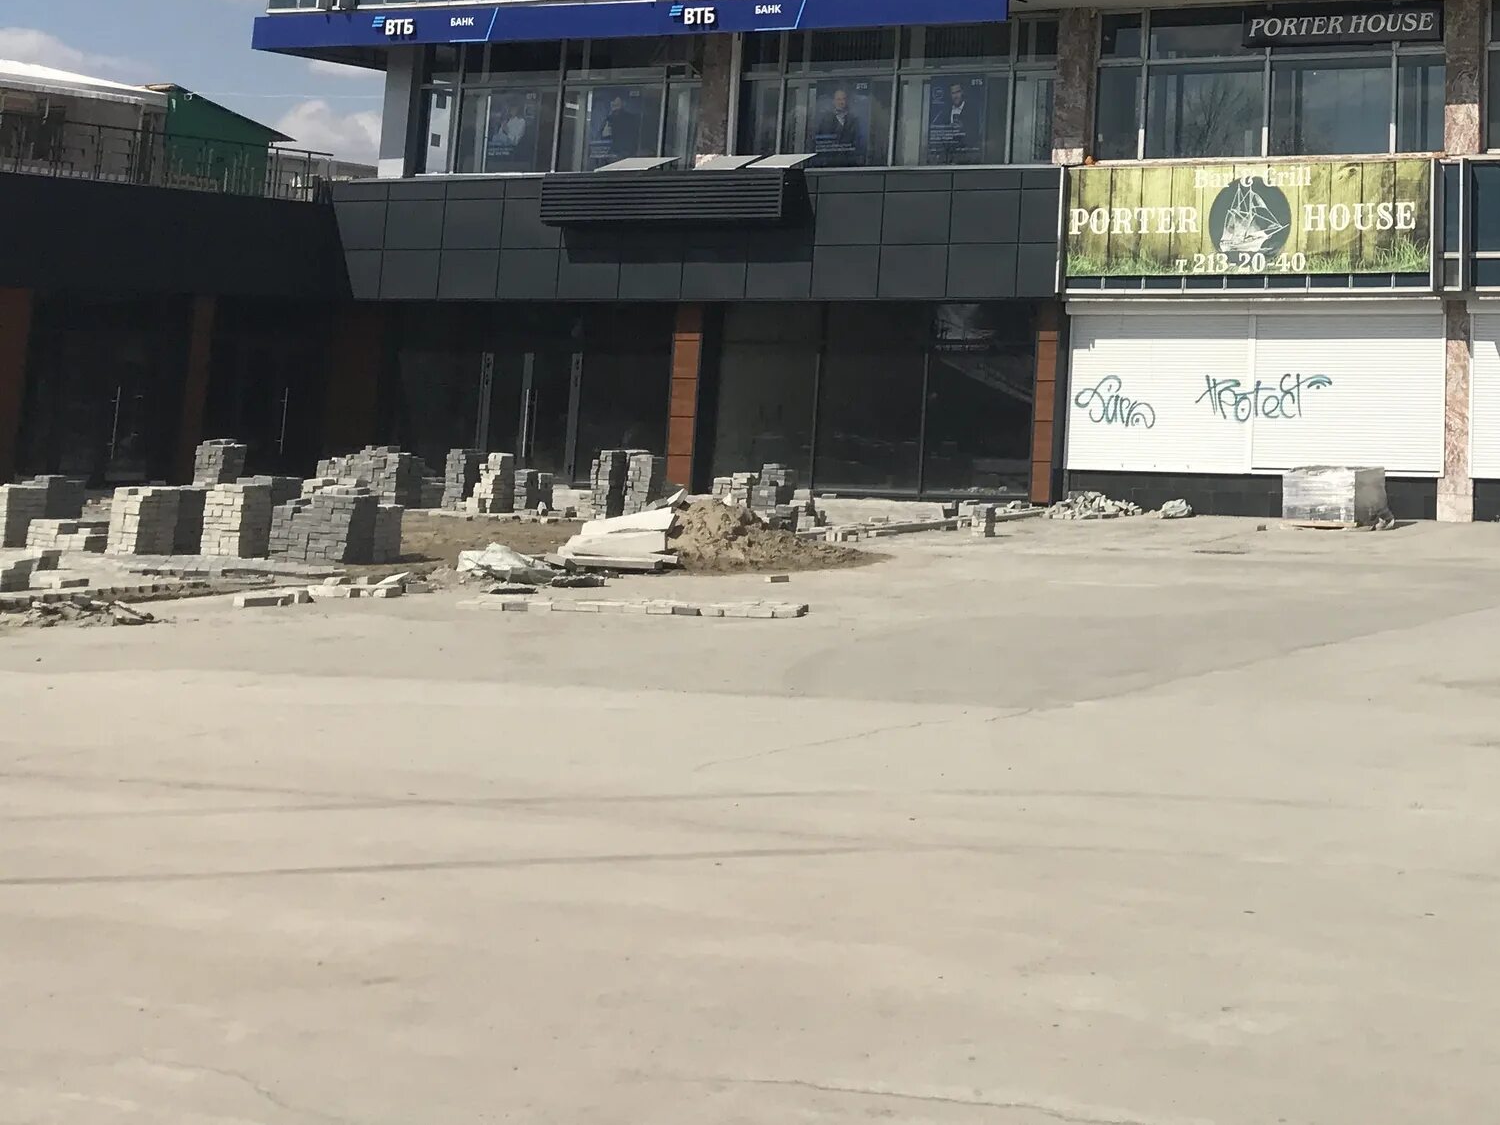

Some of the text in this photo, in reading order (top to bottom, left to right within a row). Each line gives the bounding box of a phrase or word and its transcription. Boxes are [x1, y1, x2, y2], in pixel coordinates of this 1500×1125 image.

[684, 7, 715, 25] ВТБ
[755, 4, 781, 14] БАНК
[385, 19, 414, 35] ВТБ
[450, 17, 474, 26] БАНК
[1249, 12, 1434, 37] PORTER HOUSE
[1068, 201, 1416, 236] PORTER HOUSE
[1193, 251, 1307, 274] 213-20-40
